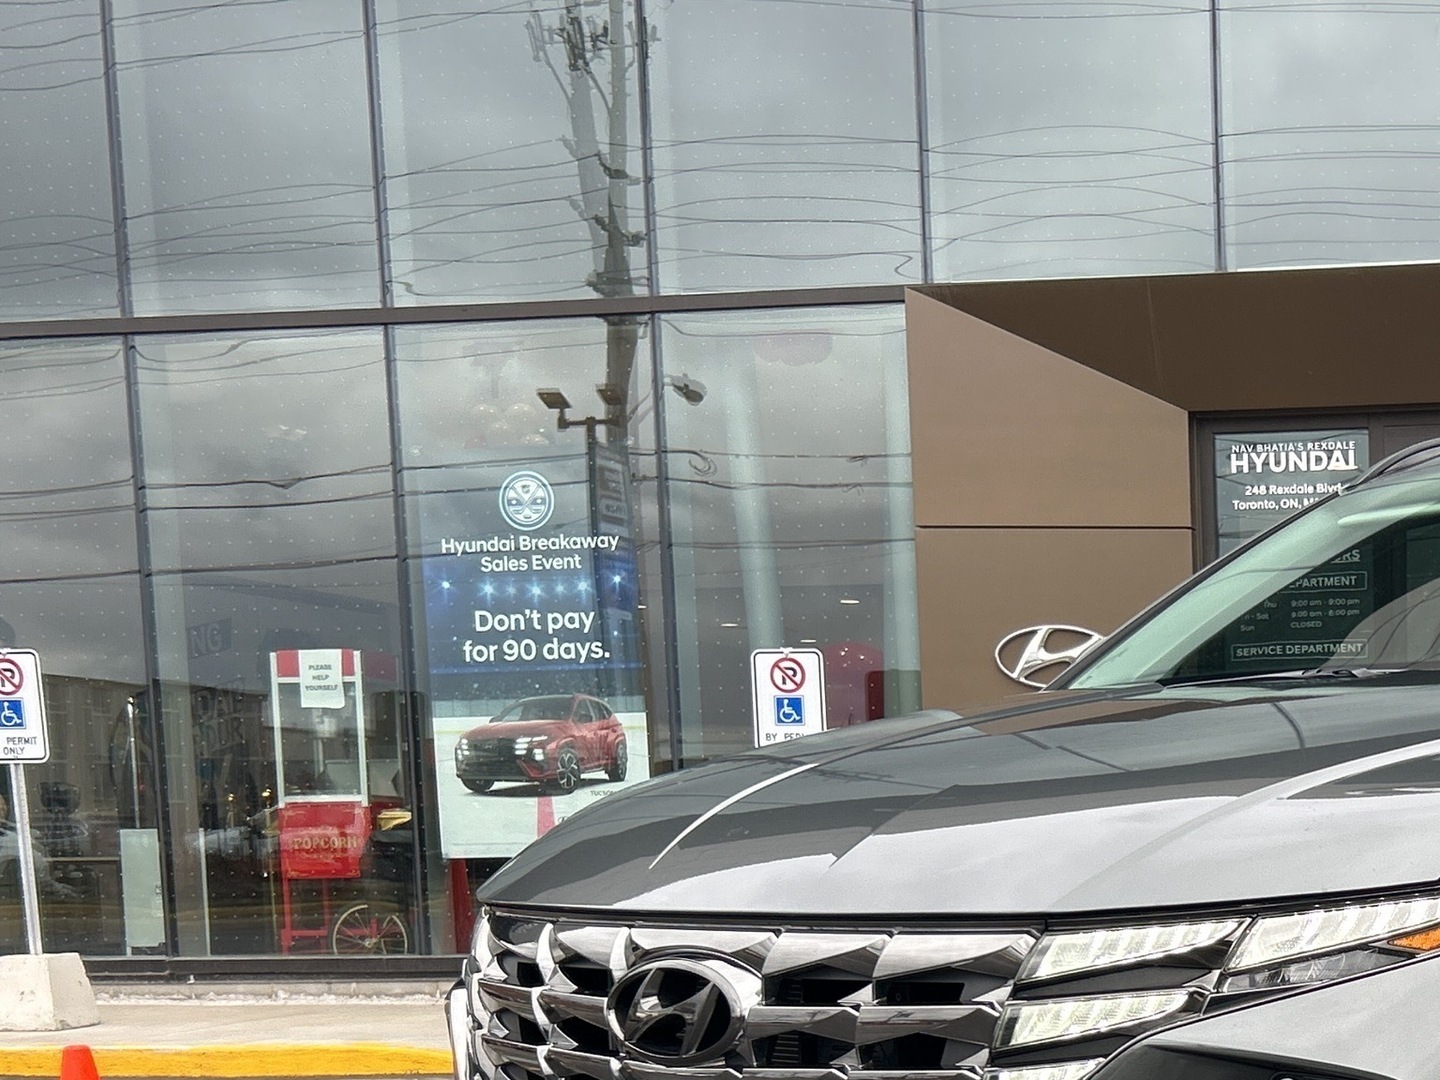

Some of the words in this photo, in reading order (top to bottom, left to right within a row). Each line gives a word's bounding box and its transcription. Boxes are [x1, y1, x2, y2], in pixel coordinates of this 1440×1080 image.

[1232, 445, 1253, 453] NAV
[1257, 443, 1304, 452] BHATIA'S
[1307, 441, 1356, 450] REXDALE
[1230, 450, 1358, 474] HYUNDAI
[1245, 485, 1268, 496] 248
[1269, 483, 1314, 495] Rexdale
[1232, 499, 1279, 511] Toronto,
[1281, 498, 1303, 510] ON,
[441, 535, 515, 556] Hyundai
[519, 535, 620, 550] Breakaway
[480, 556, 528, 572] Sales
[532, 554, 582, 570] Event
[1289, 576, 1357, 588] PARTMENT
[474, 609, 541, 632] Don't
[547, 611, 595, 634] pay
[1290, 621, 1323, 629] CLOSED
[463, 640, 498, 662] for
[502, 639, 536, 660] 90
[543, 637, 610, 663] days.
[1236, 646, 1283, 657] SERVICE
[1286, 643, 1363, 654] DEPARTMENT
[6, 736, 37, 745] PERMIT
[765, 733, 778, 742] BY
[3, 746, 25, 756] ONLY
[294, 836, 358, 849] POPCORN
